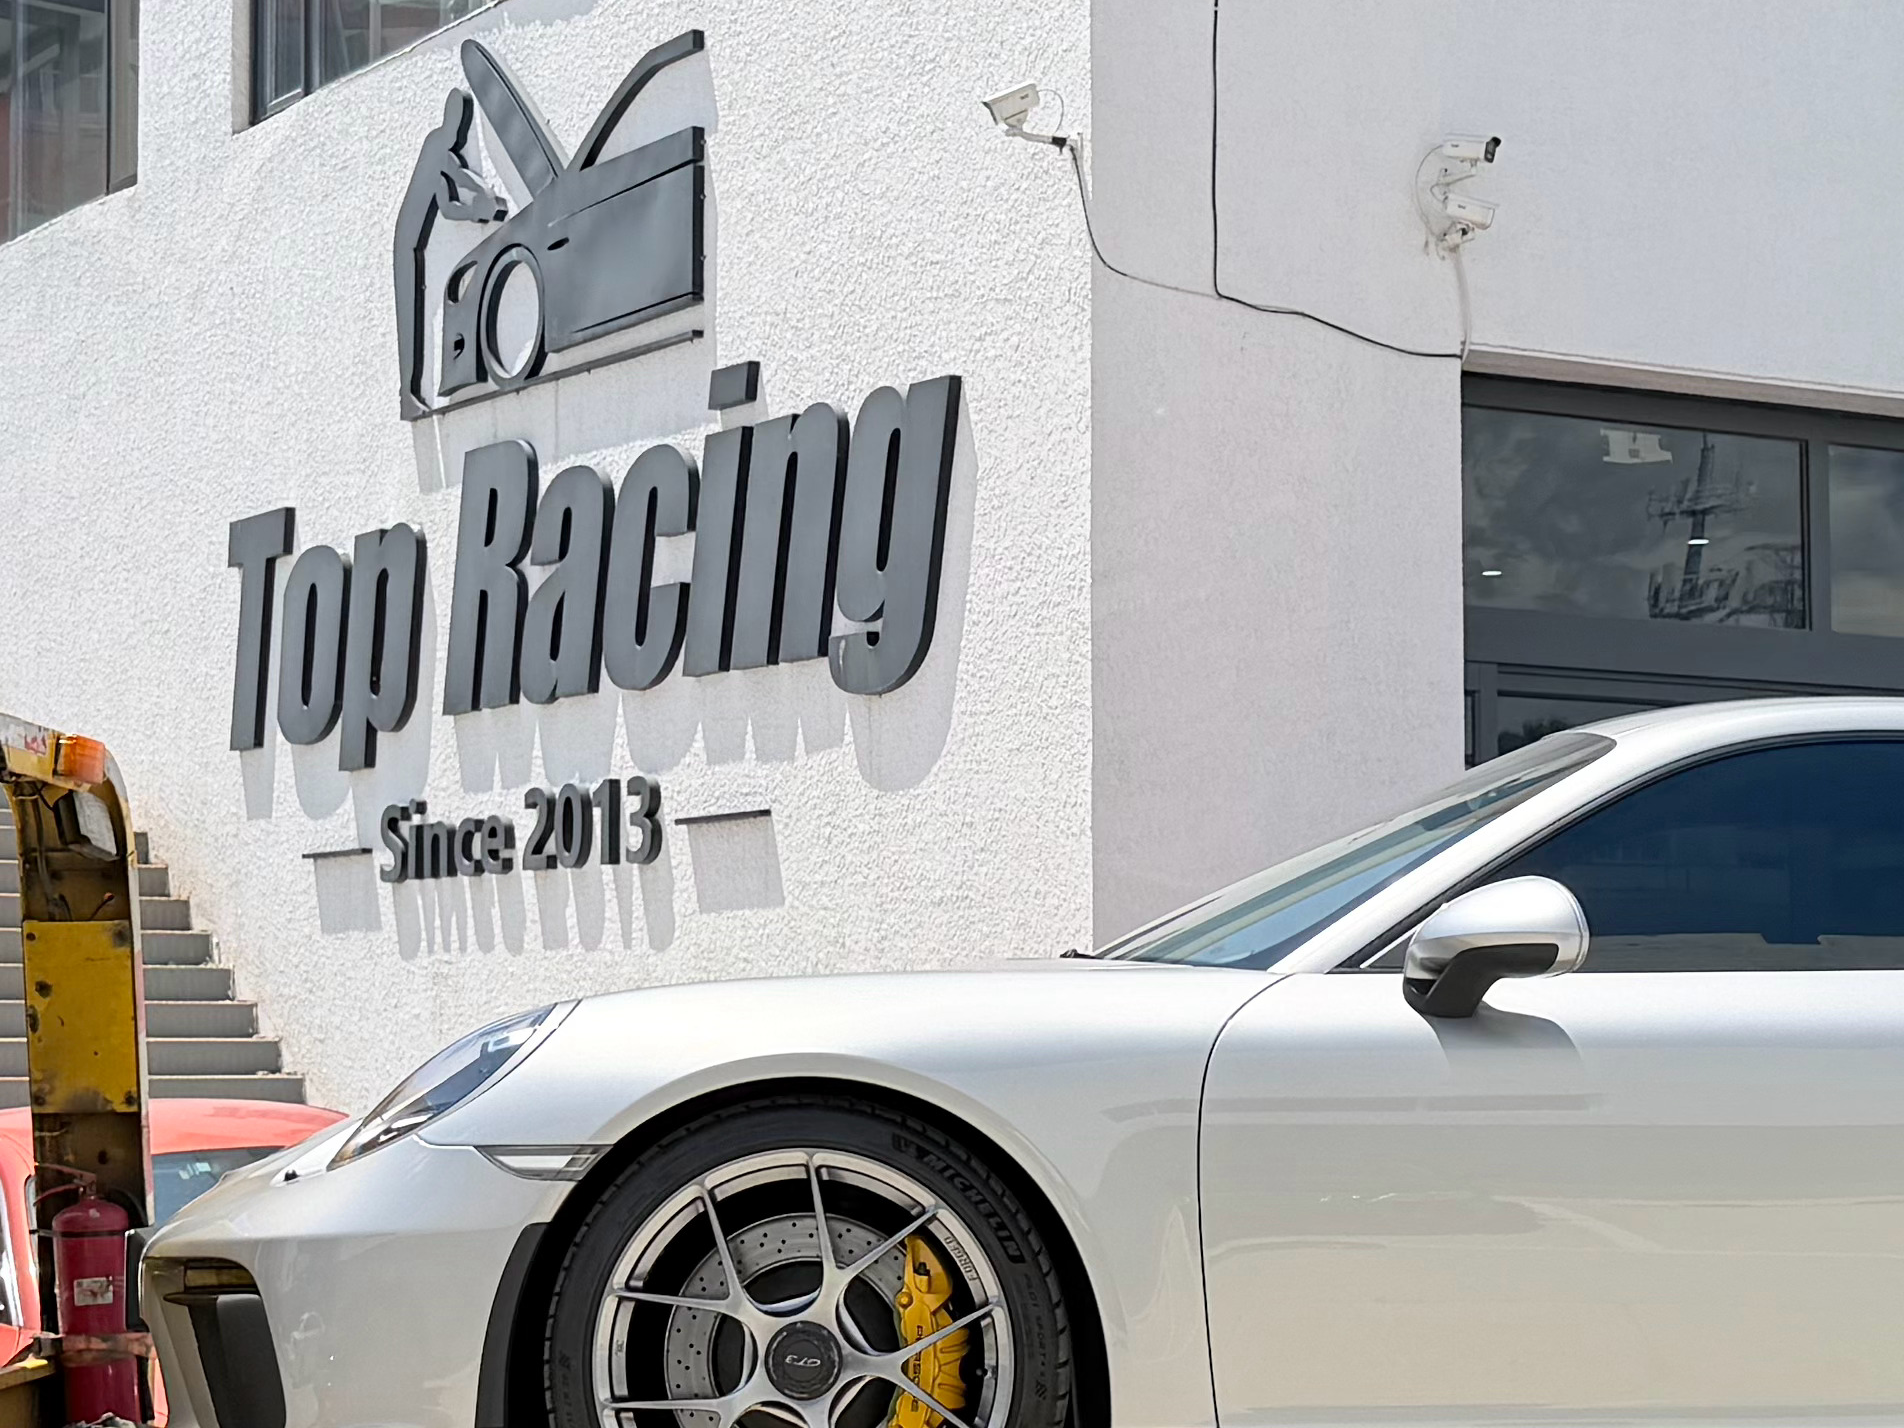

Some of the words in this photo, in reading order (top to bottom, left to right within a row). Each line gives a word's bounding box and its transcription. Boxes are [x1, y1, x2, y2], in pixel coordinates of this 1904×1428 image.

[229, 507, 427, 770] Top
[443, 361, 961, 719] Racing
[380, 800, 515, 883] Since
[523, 775, 663, 871] 2013
[922, 1153, 1022, 1261] MICHELIN
